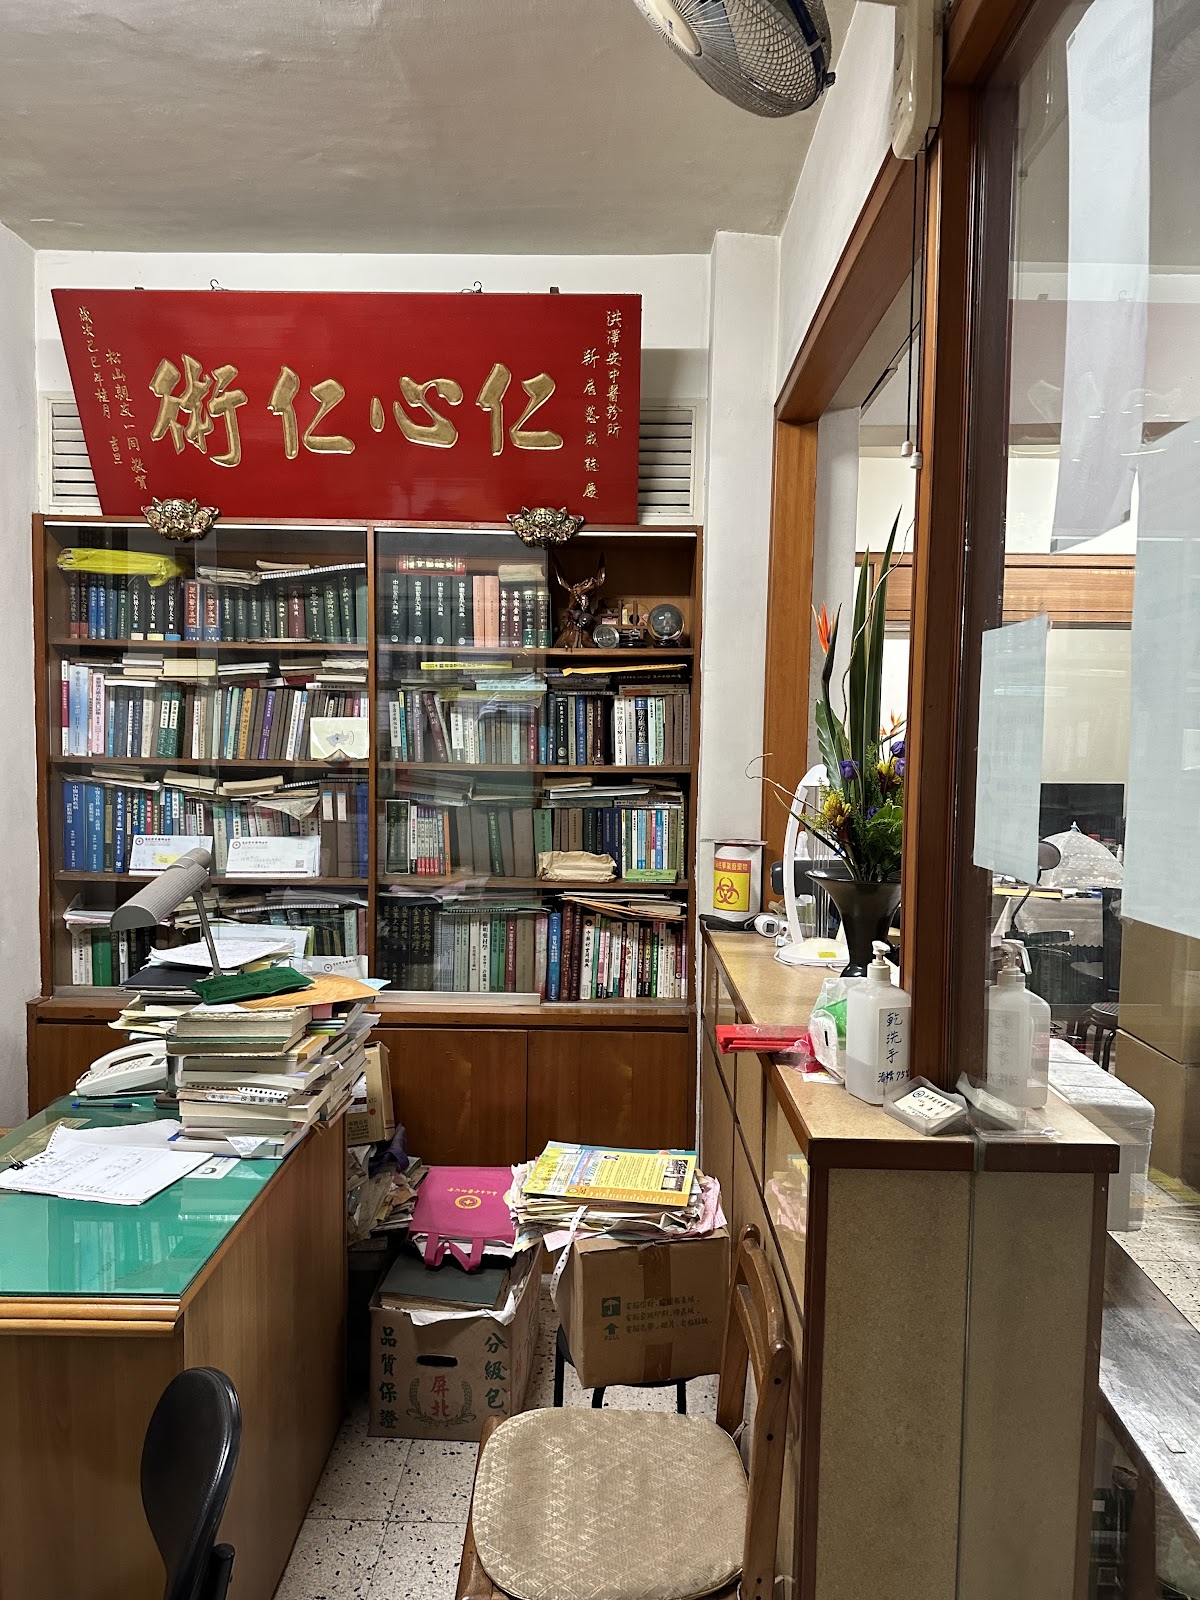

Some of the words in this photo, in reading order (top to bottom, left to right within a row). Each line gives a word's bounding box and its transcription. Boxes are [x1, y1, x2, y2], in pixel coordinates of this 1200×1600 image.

[148, 353, 564, 467] 仁心仁術
[886, 1012, 903, 1064] 乾洗手
[378, 1325, 398, 1429] 品質保證
